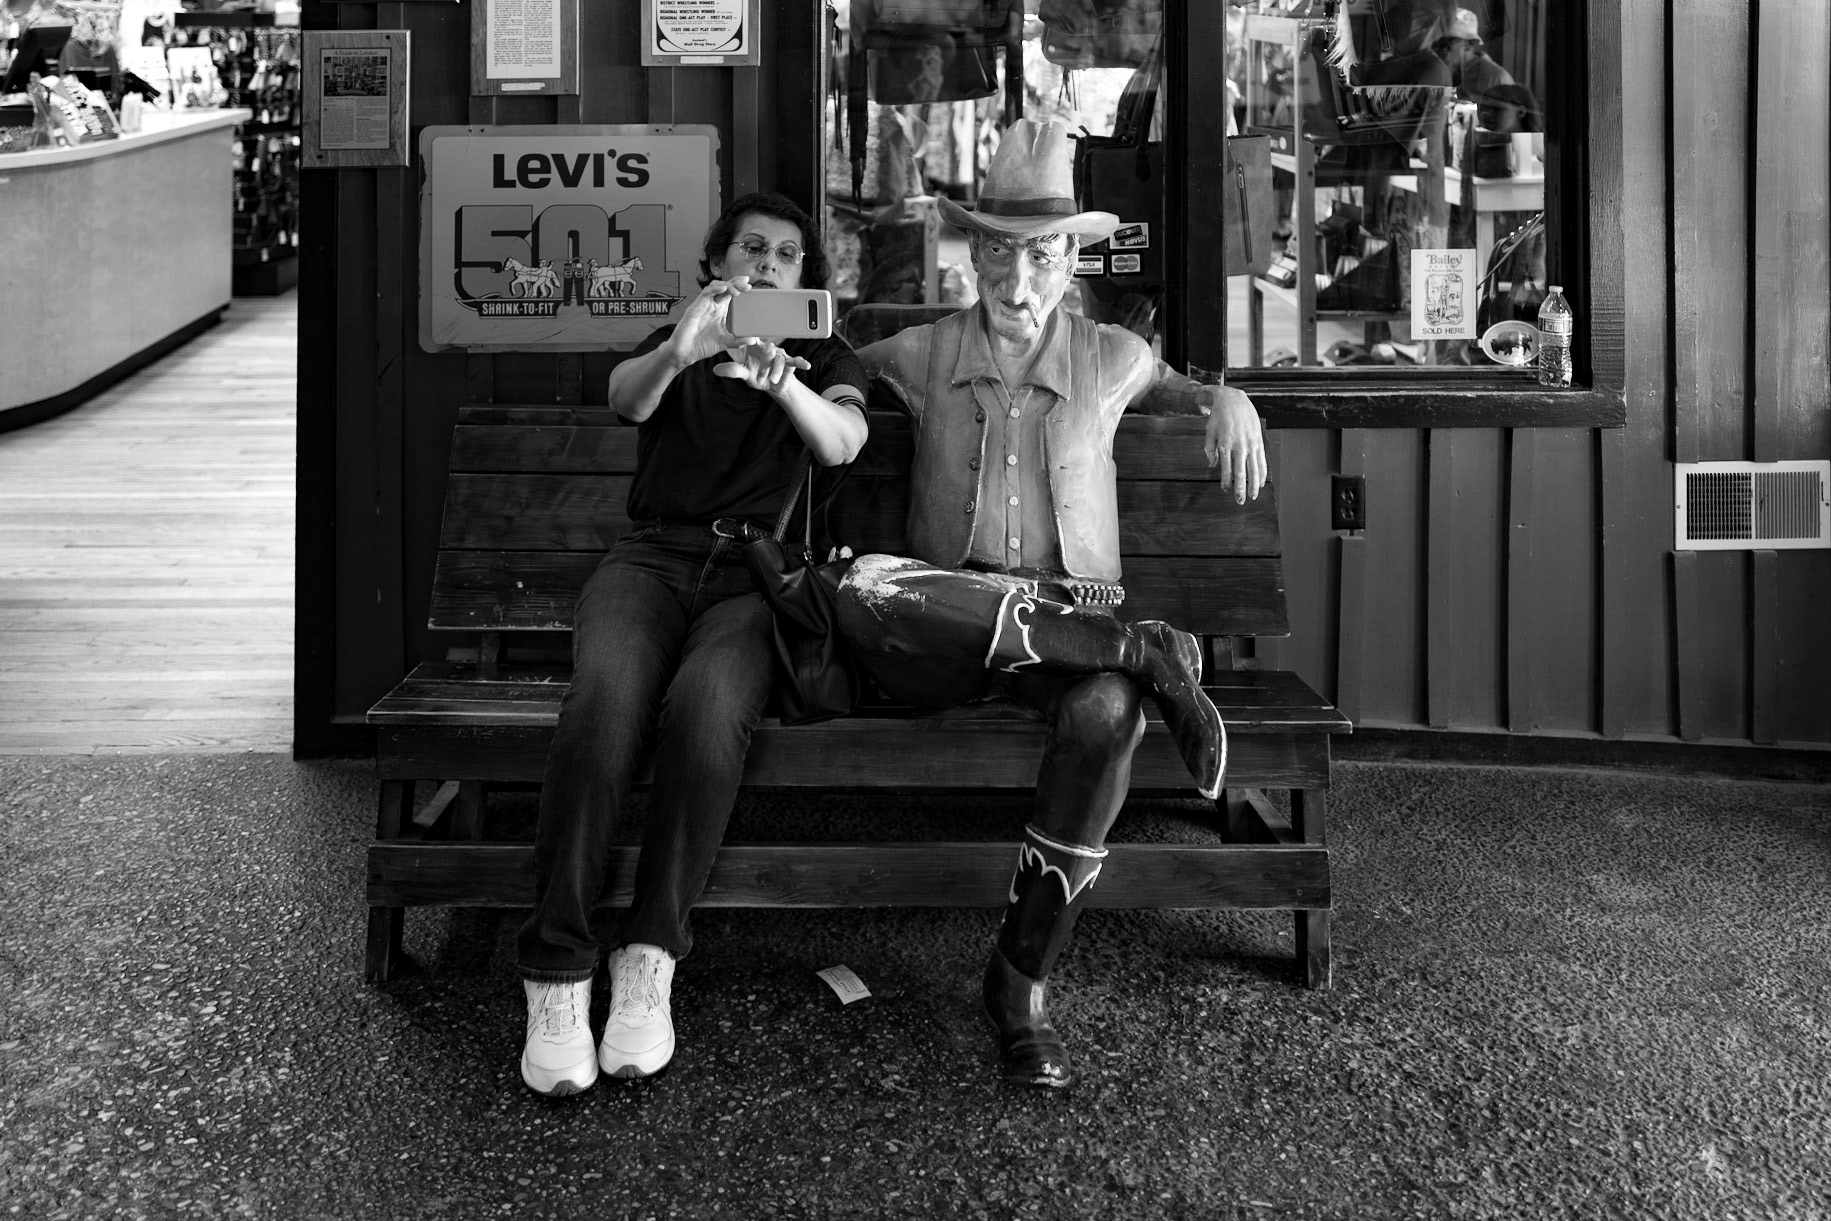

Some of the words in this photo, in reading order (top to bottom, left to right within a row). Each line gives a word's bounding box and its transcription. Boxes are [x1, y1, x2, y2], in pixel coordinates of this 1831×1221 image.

[1124, 235, 1146, 246] NOVUS
[454, 204, 680, 300] 501
[482, 302, 555, 315] SHRINK-TO-FIT
[592, 302, 606, 314] OR
[608, 301, 669, 314] PRE-SHRUNK
[1422, 327, 1443, 335] SOLD
[1445, 327, 1465, 335] HERE
